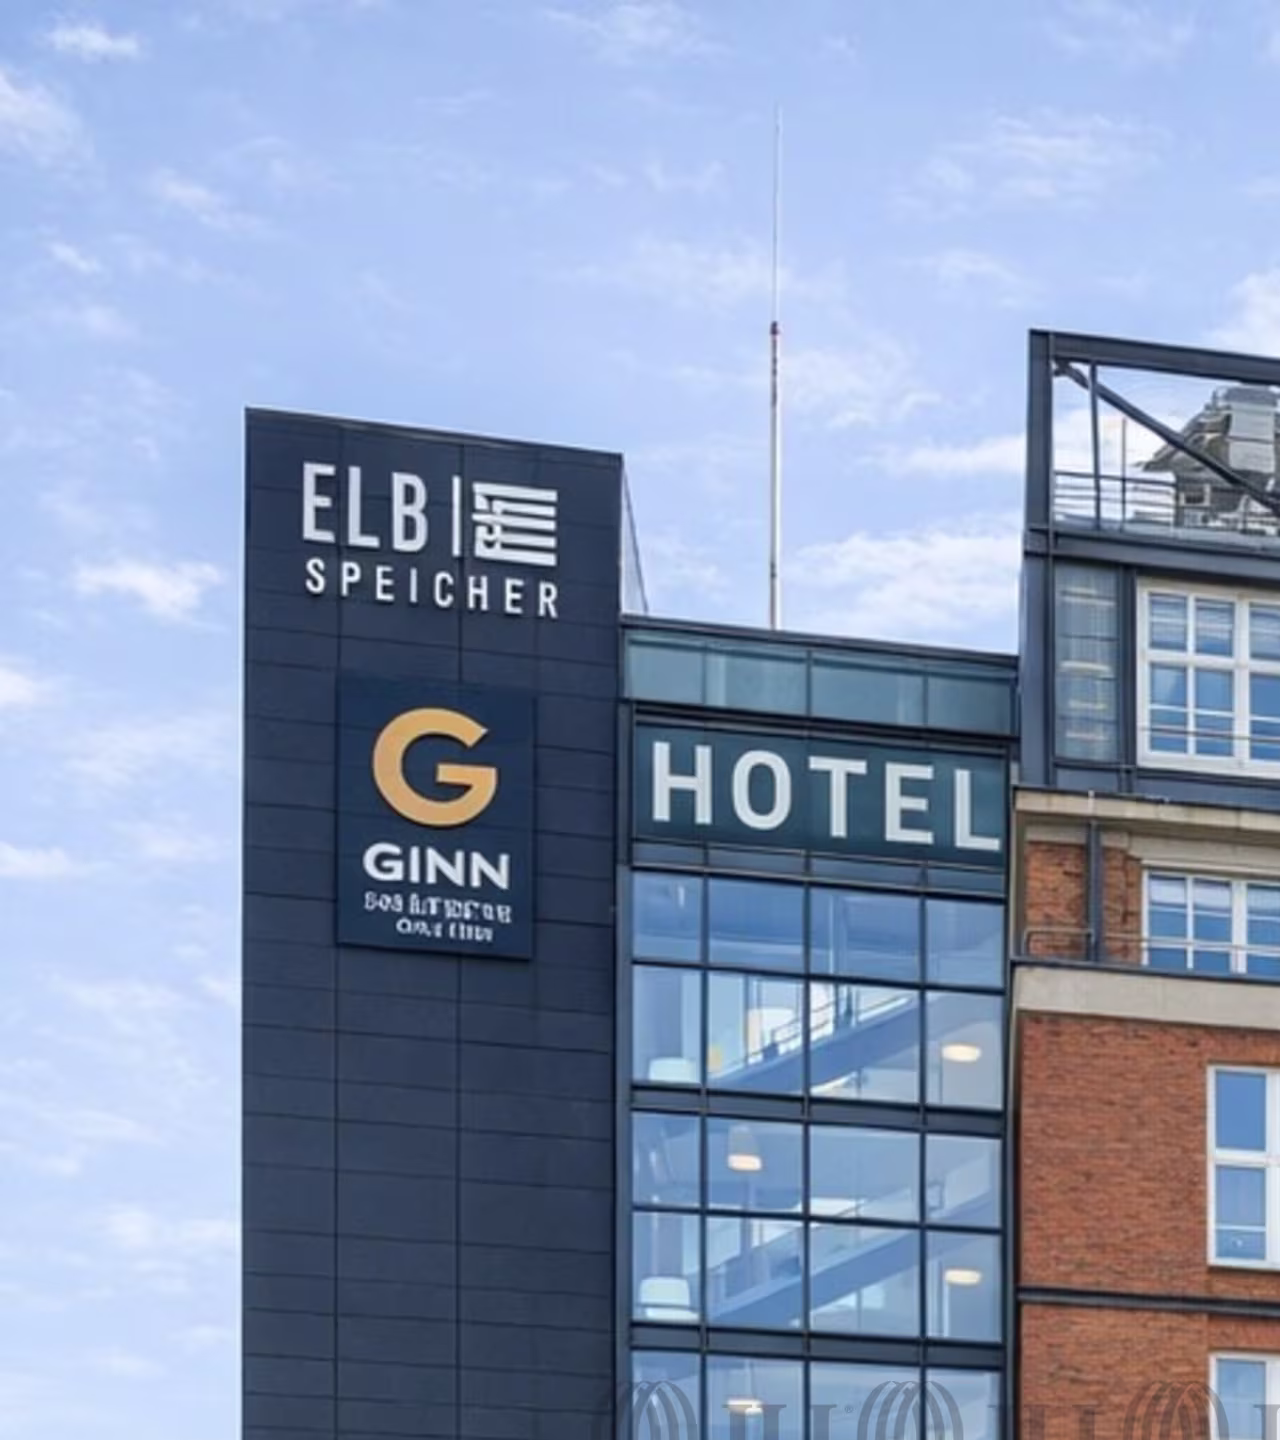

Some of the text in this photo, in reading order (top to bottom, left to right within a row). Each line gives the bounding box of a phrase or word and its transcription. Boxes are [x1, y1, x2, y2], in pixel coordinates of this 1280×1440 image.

[304, 557, 559, 619] SPEICHER
[652, 740, 1001, 851] HOTEL
[362, 841, 510, 890] GINN
